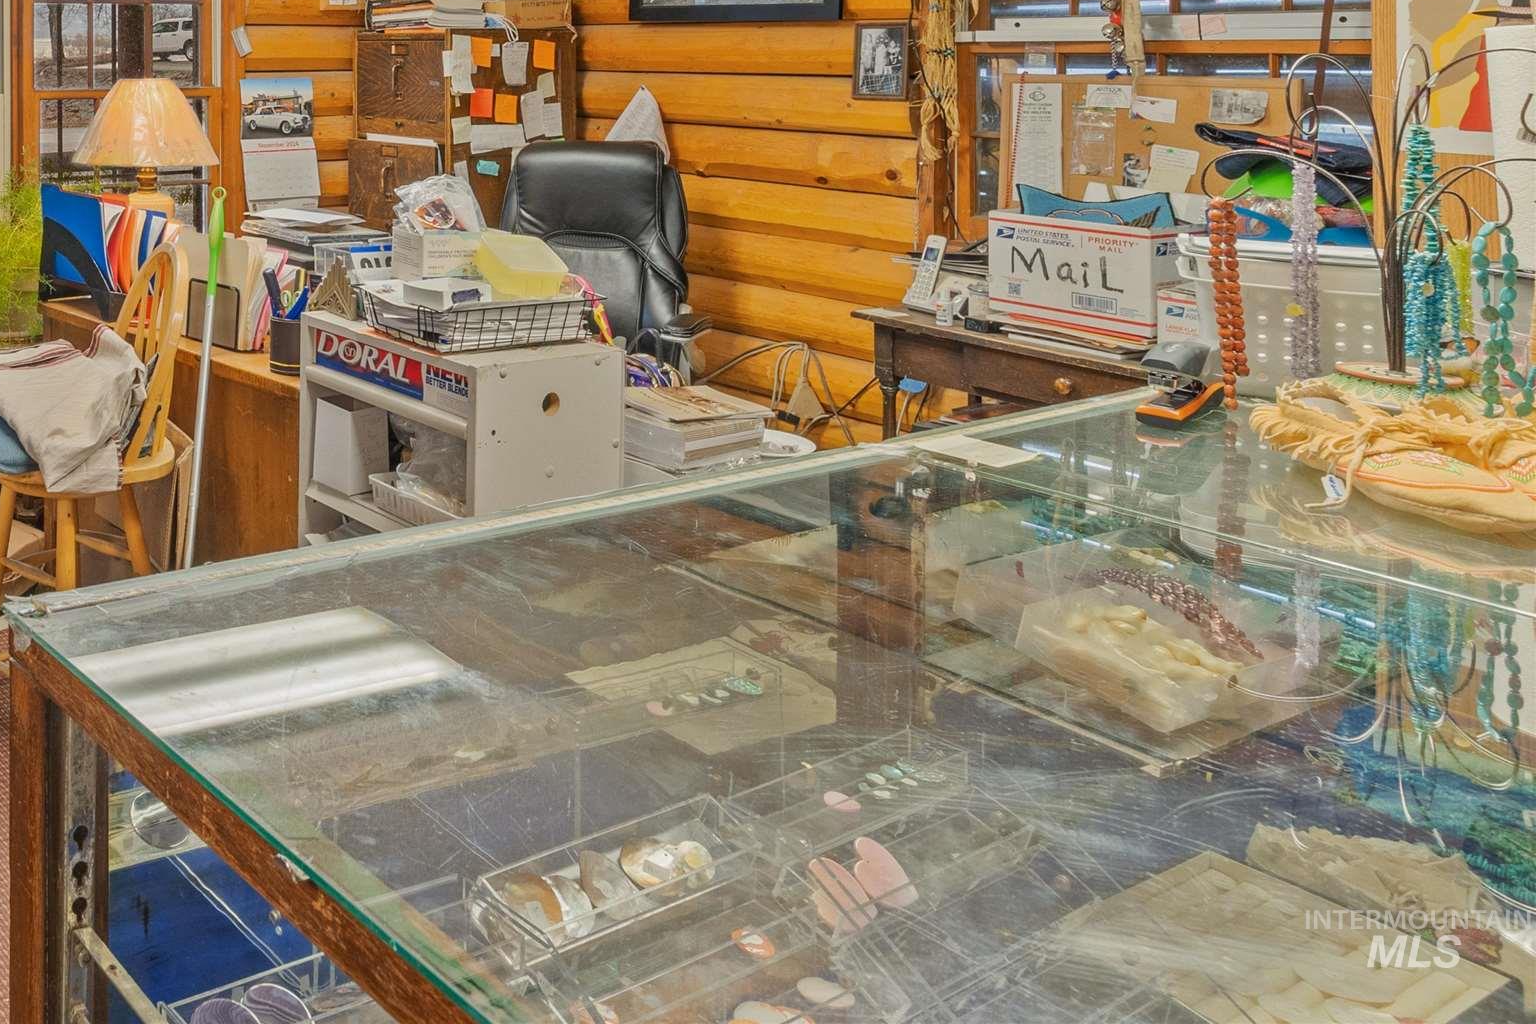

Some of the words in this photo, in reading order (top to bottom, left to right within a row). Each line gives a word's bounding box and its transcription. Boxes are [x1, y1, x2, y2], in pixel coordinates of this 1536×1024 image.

[1017, 228, 1043, 237] UNITED
[1045, 230, 1069, 239] STATES
[1016, 235, 1041, 244] POSTAL
[1088, 236, 1135, 247] PRIORITY
[1099, 245, 1124, 254] MAIL
[317, 331, 410, 384] DORAL
[425, 376, 447, 391] BETTER
